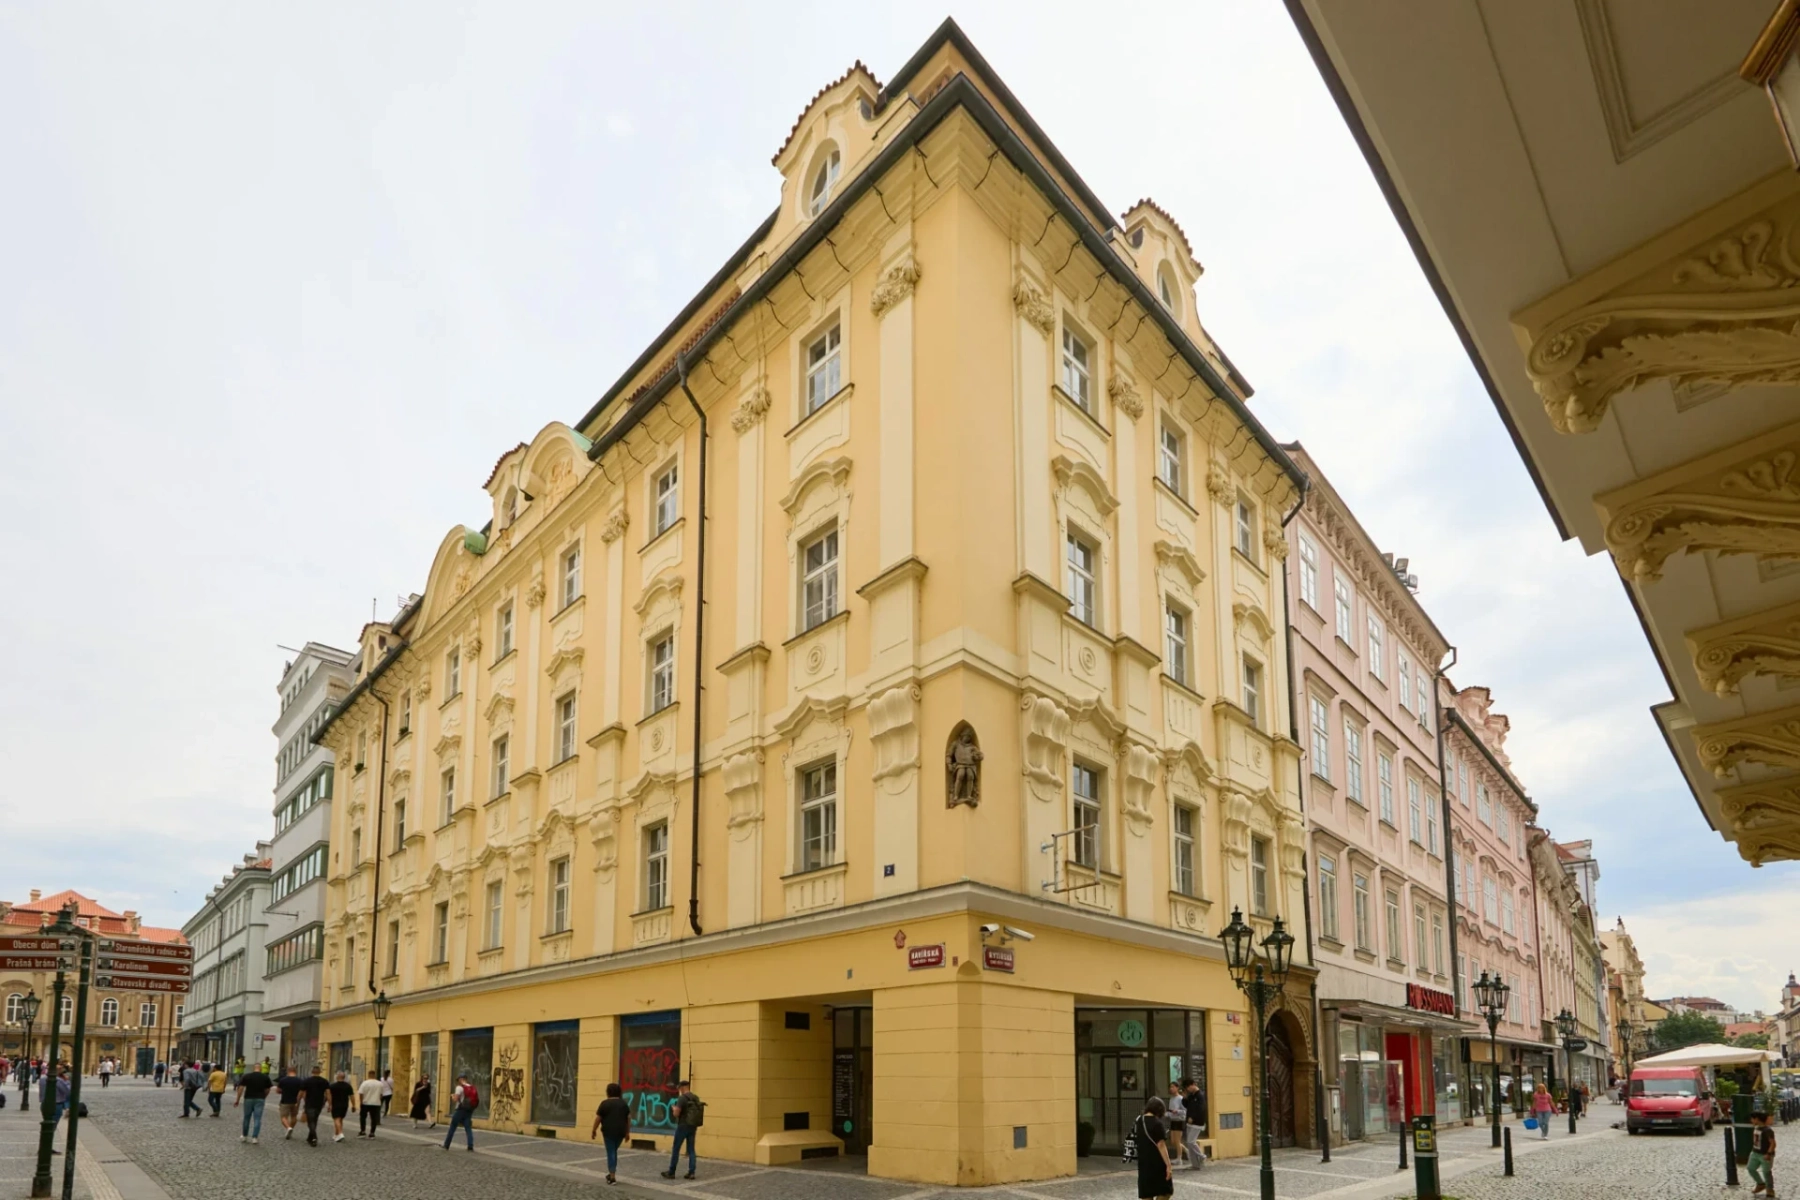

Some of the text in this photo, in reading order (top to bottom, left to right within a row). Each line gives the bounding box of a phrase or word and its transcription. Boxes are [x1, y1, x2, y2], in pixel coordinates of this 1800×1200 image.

[13, 940, 57, 949] Obecní dům
[115, 943, 178, 956] Staroměstská radnice
[6, 958, 56, 967] Prašná brána
[114, 961, 149, 971] Karolinum
[113, 978, 171, 990] Stavovské divadlo
[1409, 983, 1454, 1015] ROSSMANN
[1120, 1030, 1142, 1041] GO
